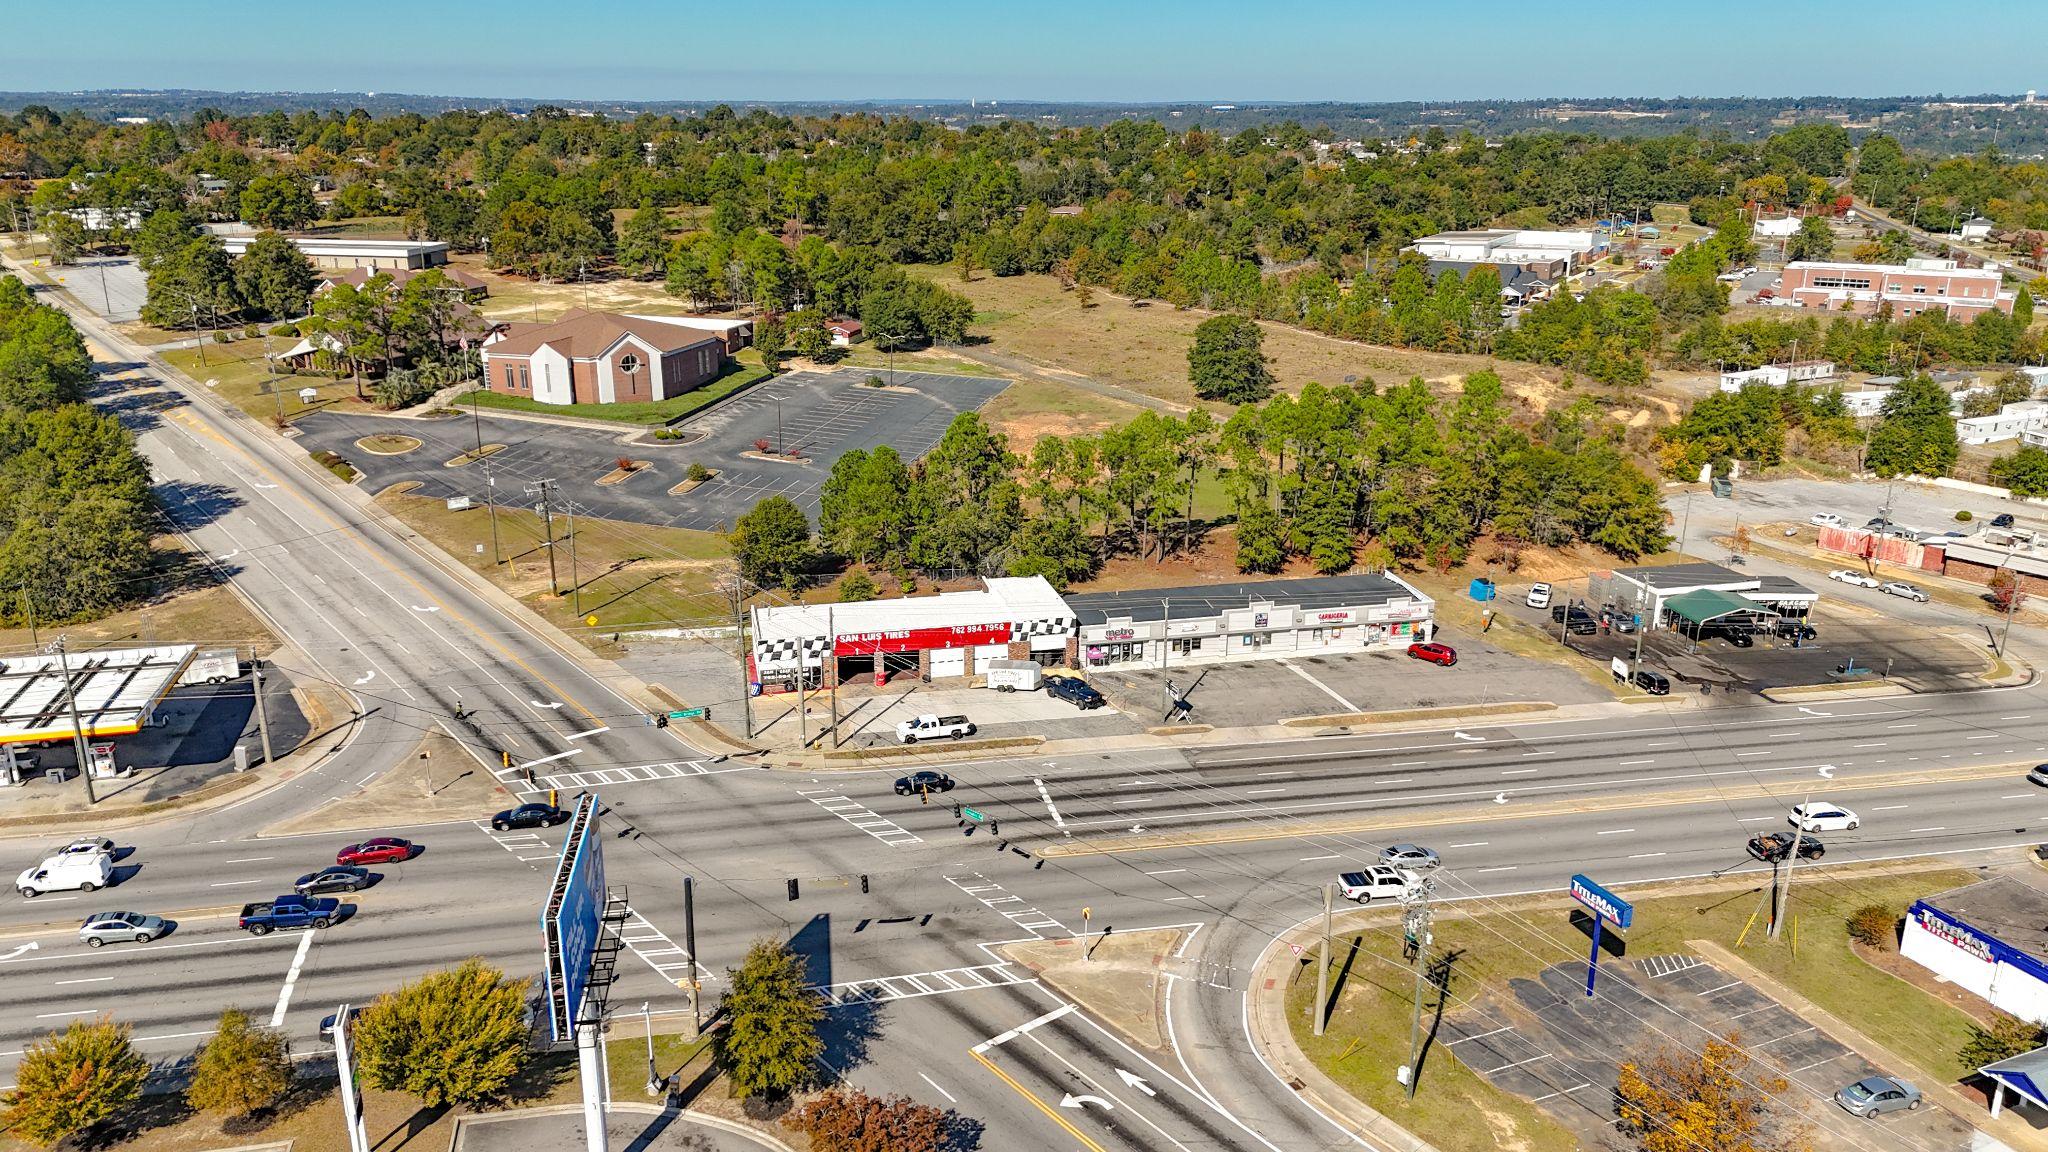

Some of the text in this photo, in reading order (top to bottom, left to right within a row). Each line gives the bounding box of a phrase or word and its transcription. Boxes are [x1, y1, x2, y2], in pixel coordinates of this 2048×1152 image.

[951, 626, 965, 634] 762
[984, 623, 1005, 631] 7956
[1105, 628, 1134, 636] metro
[839, 630, 911, 643] SAN LUIS TIRES
[945, 640, 951, 648] 3
[1926, 924, 1988, 961] TITLE PAWN
